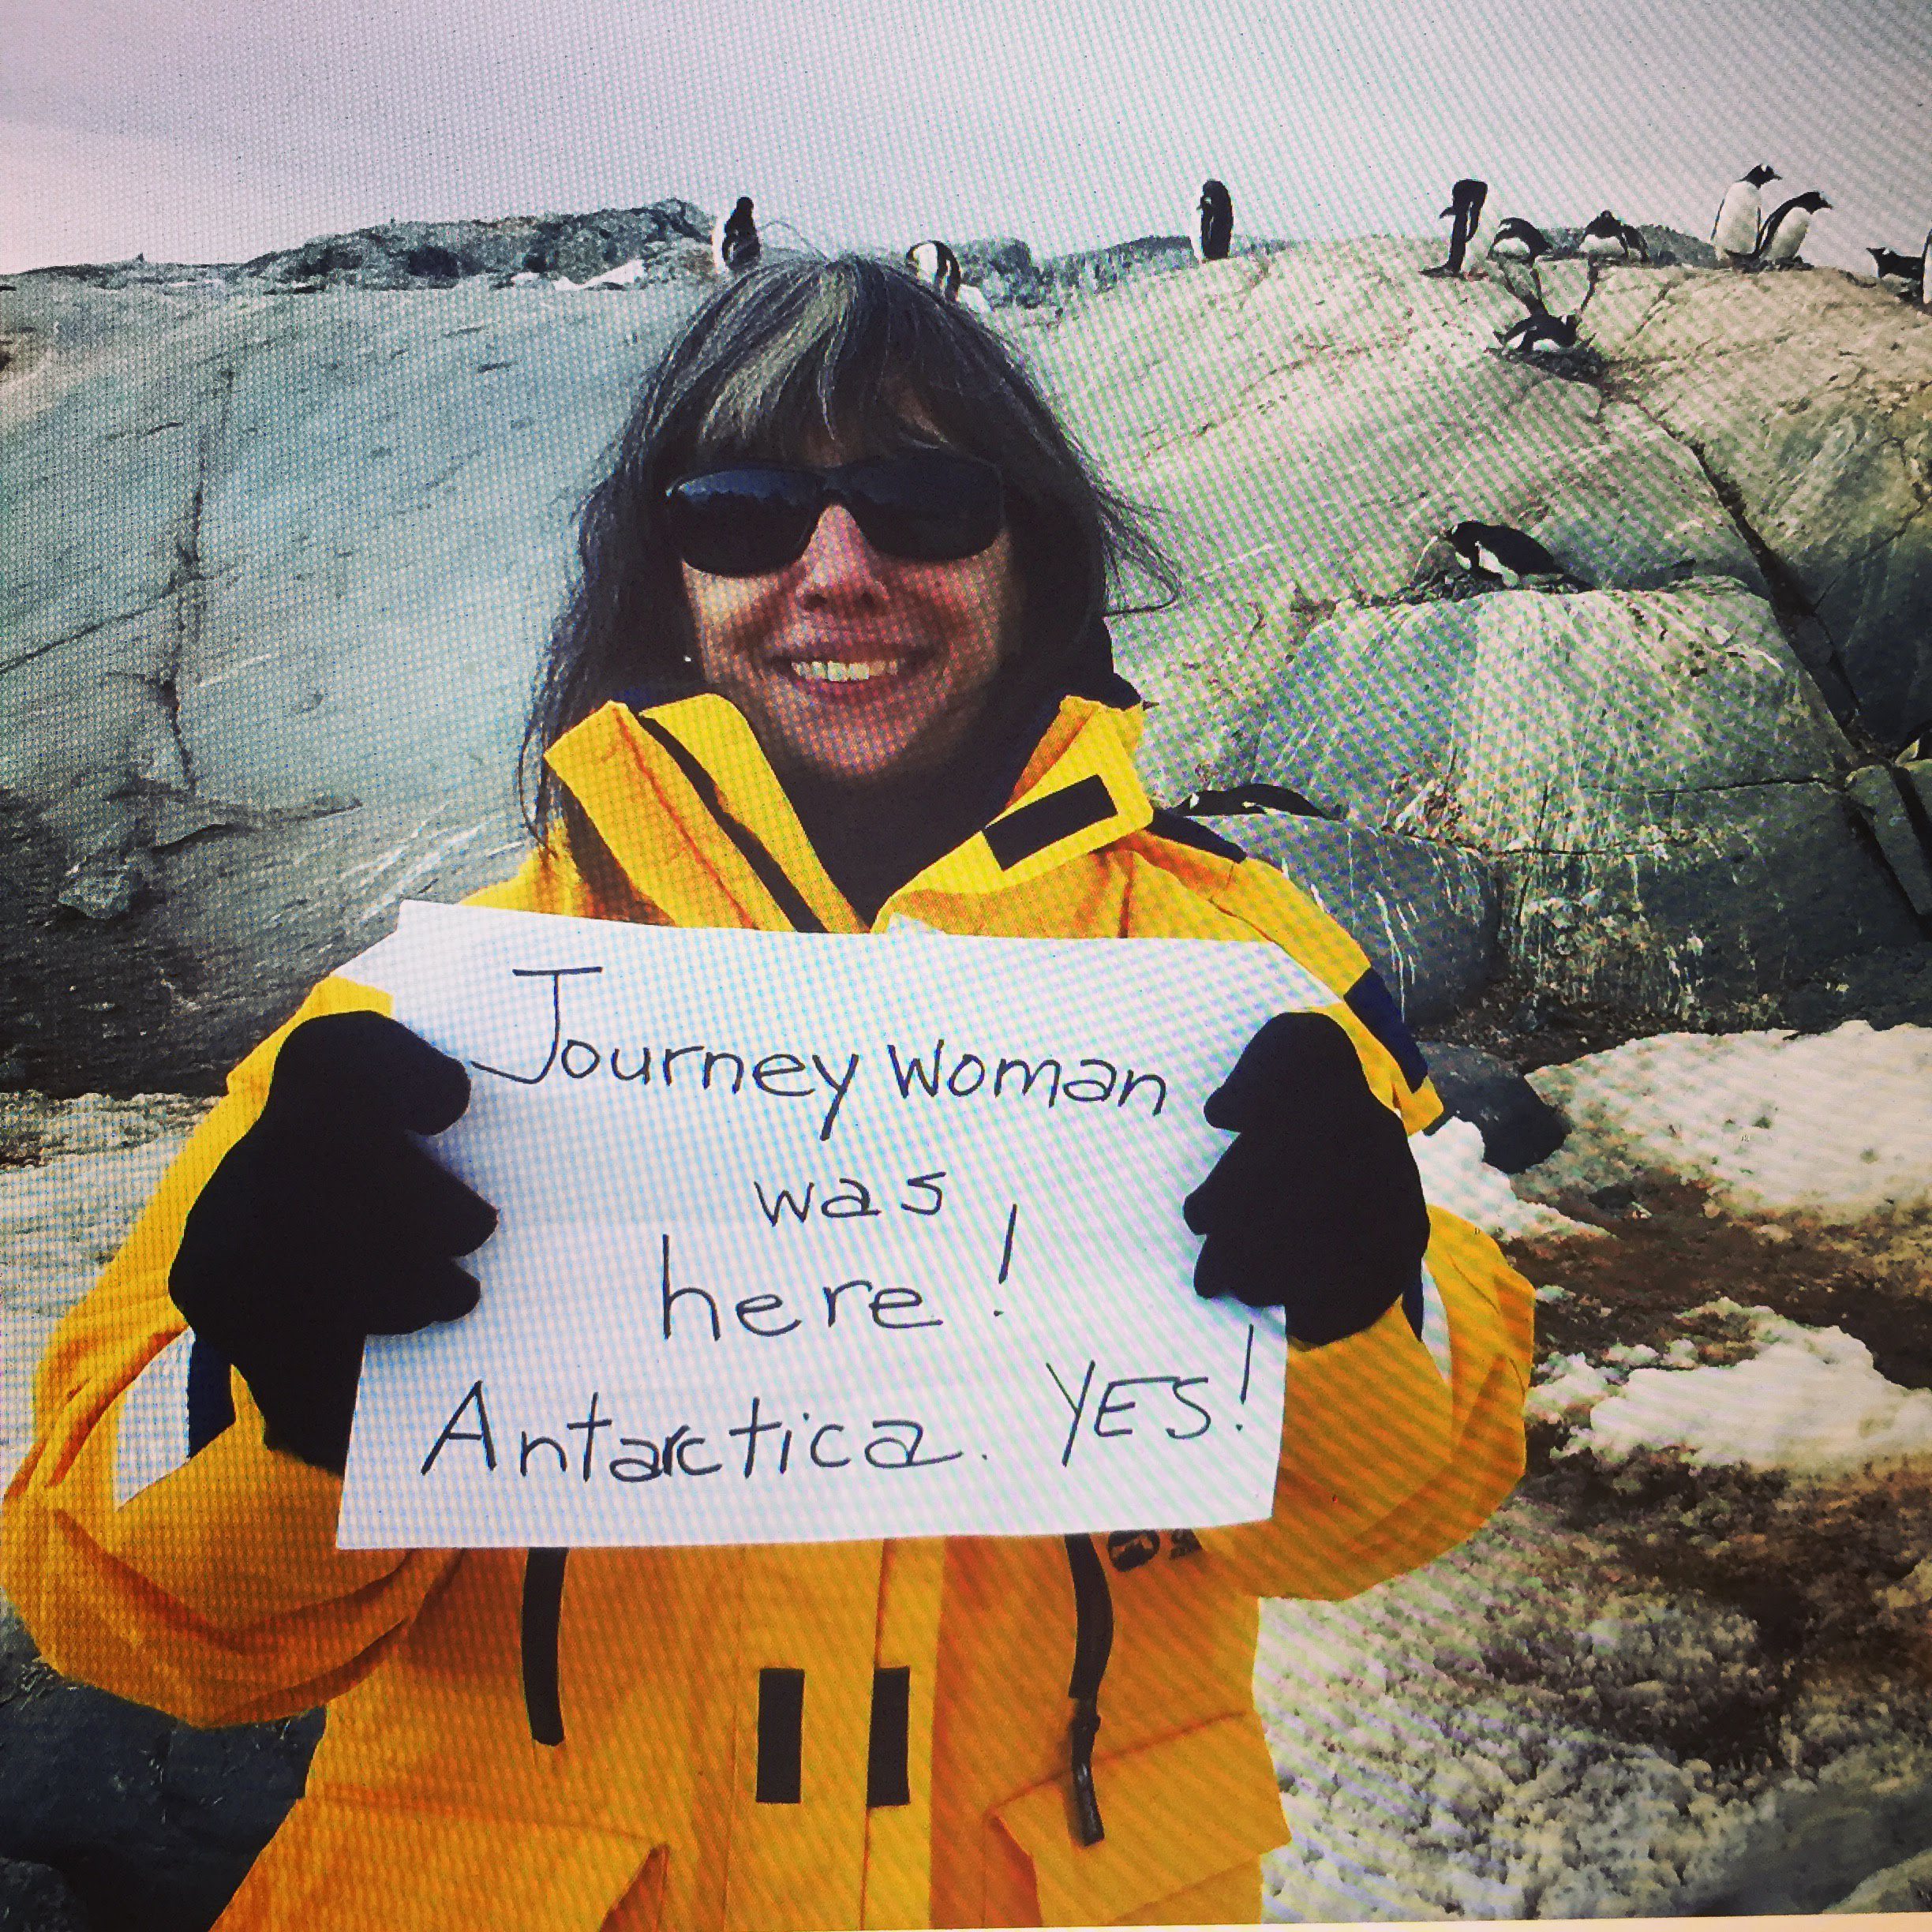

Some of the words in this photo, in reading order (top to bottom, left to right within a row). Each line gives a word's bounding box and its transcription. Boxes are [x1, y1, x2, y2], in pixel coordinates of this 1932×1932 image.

[470, 966, 859, 1141] Journey
[886, 1038, 1167, 1117] Woman
[754, 1171, 947, 1227] was
[420, 1380, 989, 1484] Antarctica.
